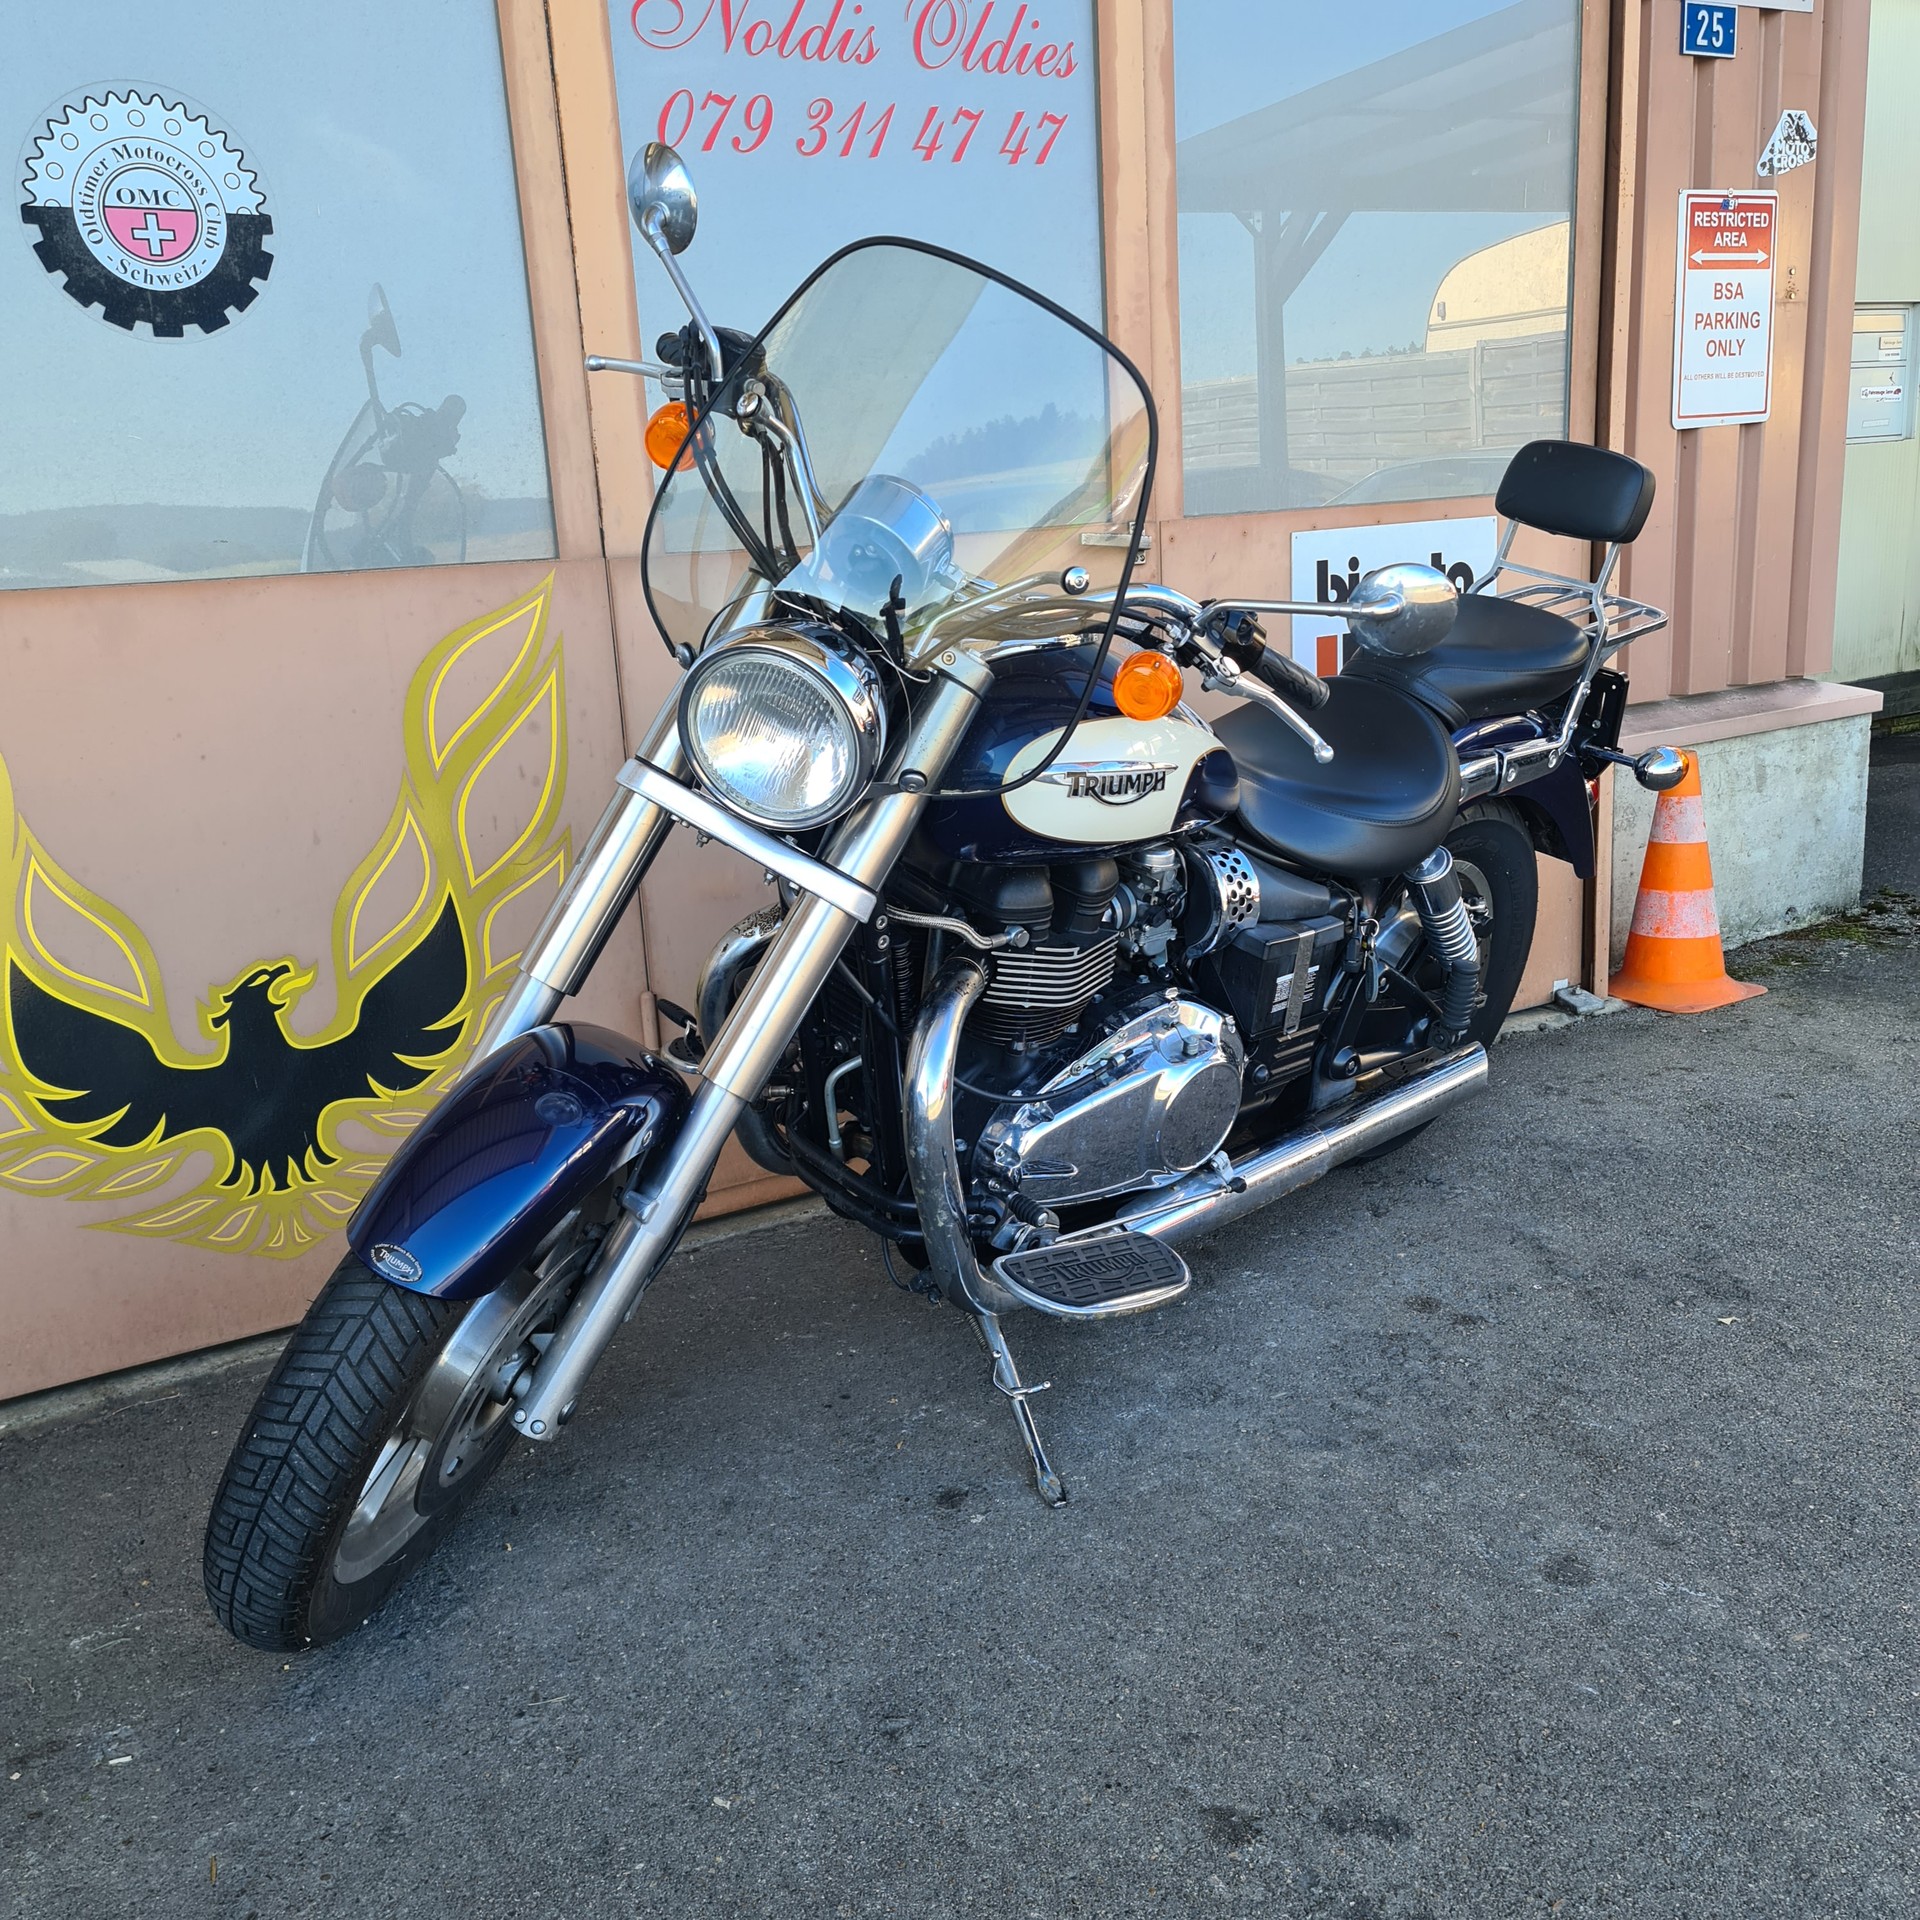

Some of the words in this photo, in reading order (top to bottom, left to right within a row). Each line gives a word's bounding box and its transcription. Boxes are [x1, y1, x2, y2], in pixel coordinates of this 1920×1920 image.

[631, 0, 880, 64] Noldis
[905, 0, 1078, 78] Oldies
[1696, 9, 1724, 48] 25
[657, 88, 774, 153] 079
[796, 98, 896, 158] 311
[912, 105, 984, 163] 47
[999, 111, 1069, 165] 47
[79, 158, 109, 245] Oldtimer
[110, 143, 208, 196] Motocross
[204, 202, 222, 249] Club
[116, 187, 181, 207] OMC
[1694, 211, 1769, 228] RESTRICTED
[1713, 231, 1748, 247] AREA
[115, 258, 202, 286] Schweiz
[1713, 282, 1744, 300] BSA
[1694, 311, 1761, 330] PARKING
[1706, 338, 1746, 357] ONLY
[1066, 771, 1167, 804] TRIUMPH
[380, 1249, 414, 1275] TRIUMPH
[1049, 1251, 1150, 1281] TRIUMPH
